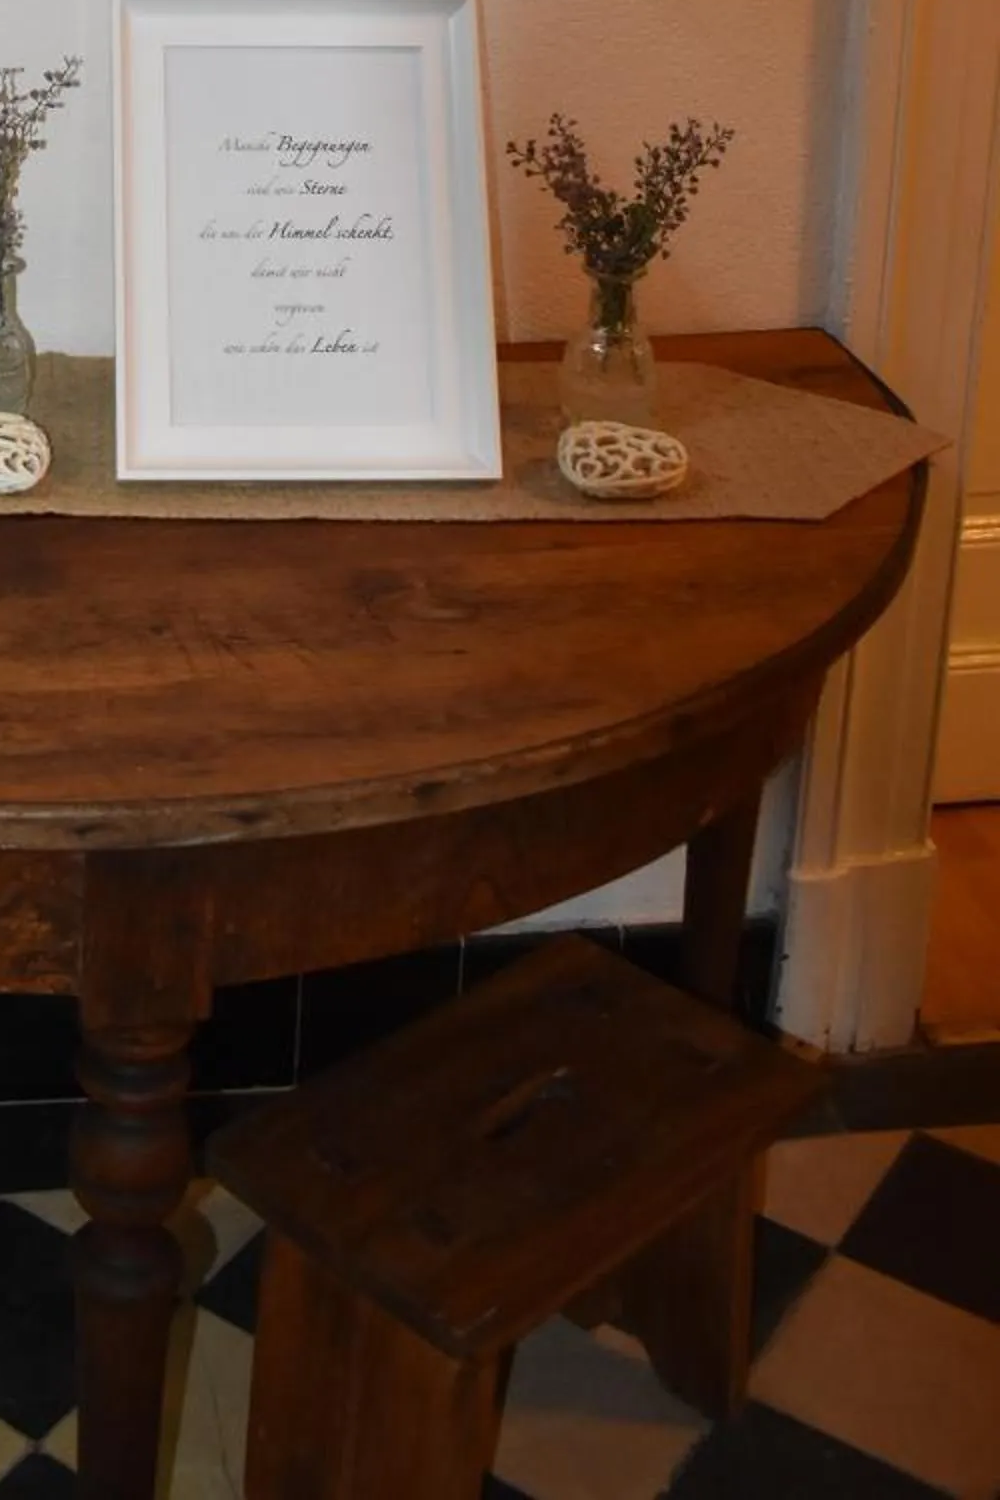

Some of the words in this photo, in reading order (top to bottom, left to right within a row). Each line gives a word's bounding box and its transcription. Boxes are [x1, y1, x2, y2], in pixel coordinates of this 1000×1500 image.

[276, 134, 371, 168] Begegnungen
[298, 179, 346, 196] Sterne
[269, 214, 338, 240] Himmel
[309, 328, 357, 353] Leben
